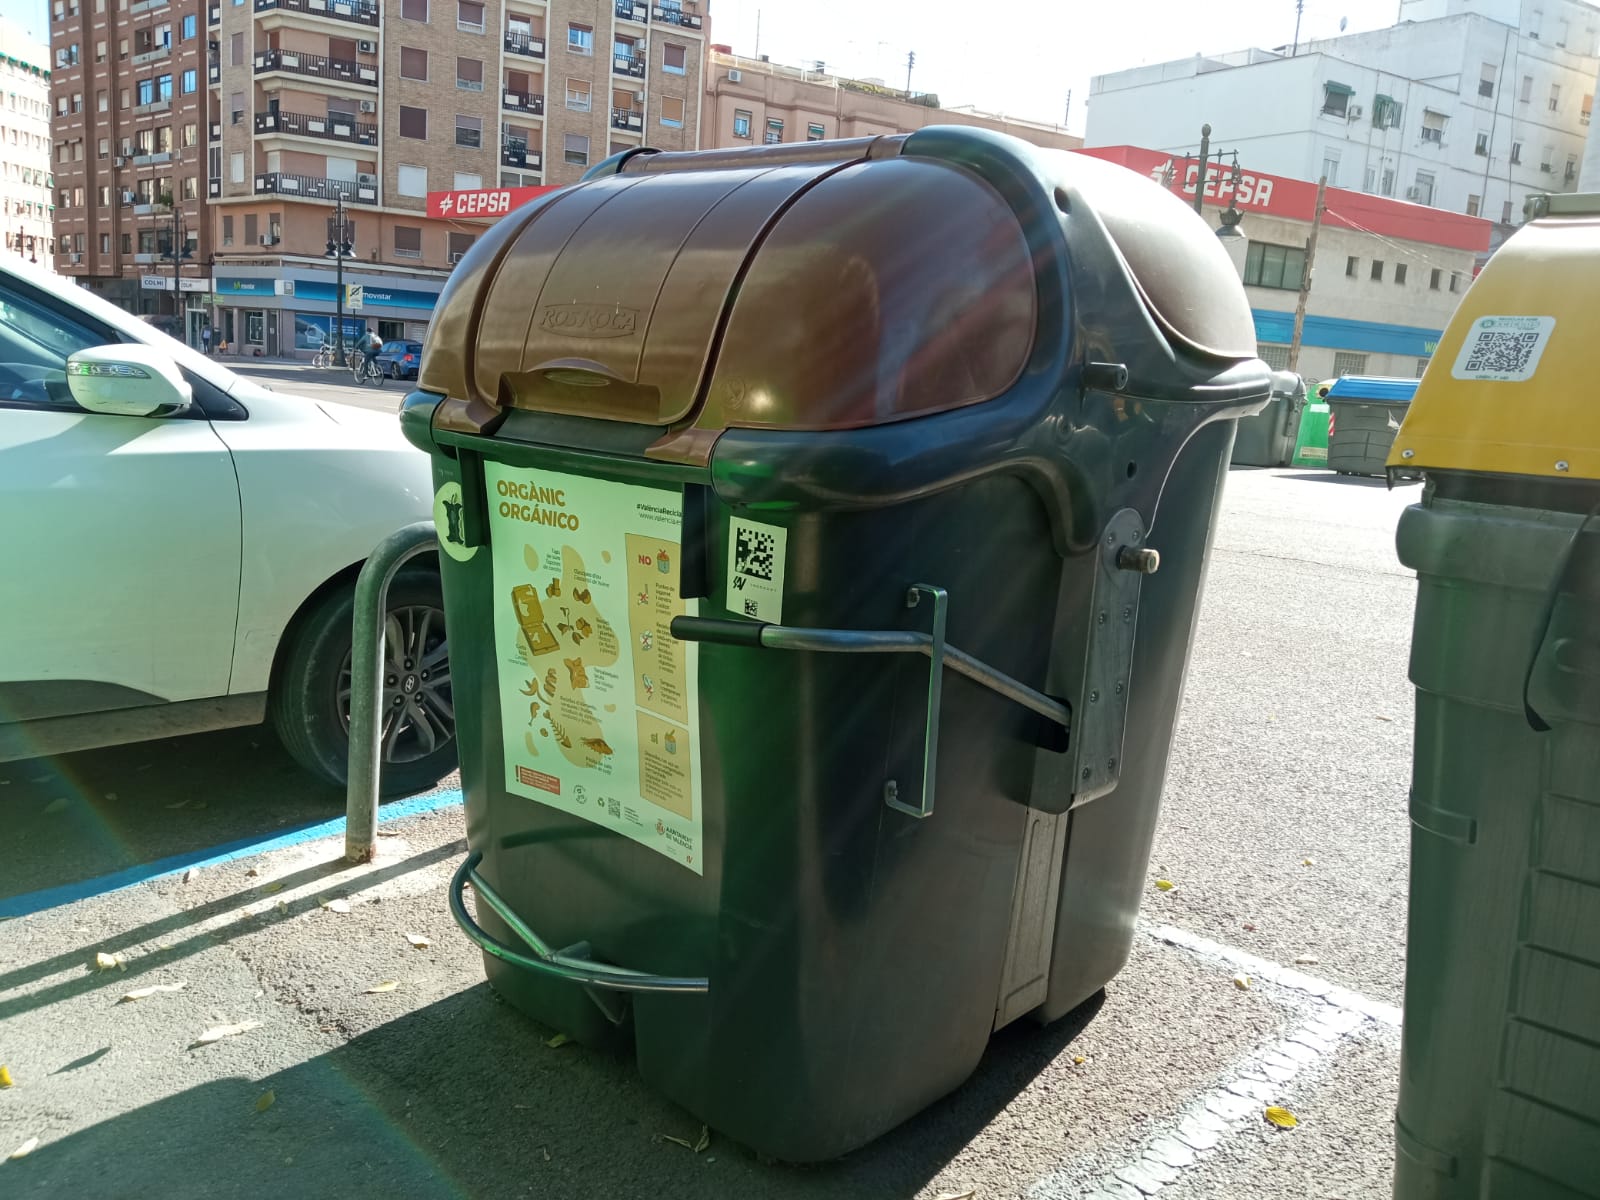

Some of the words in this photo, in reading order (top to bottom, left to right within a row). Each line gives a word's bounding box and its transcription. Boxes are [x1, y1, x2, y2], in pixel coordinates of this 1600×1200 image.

[1183, 164, 1273, 207] CEPSA
[457, 192, 511, 214] CEPSA
[362, 292, 392, 301] movistar
[497, 480, 566, 507] ORGÀNIC
[499, 502, 580, 531] ORGÁNICO
[638, 554, 651, 566] NO
